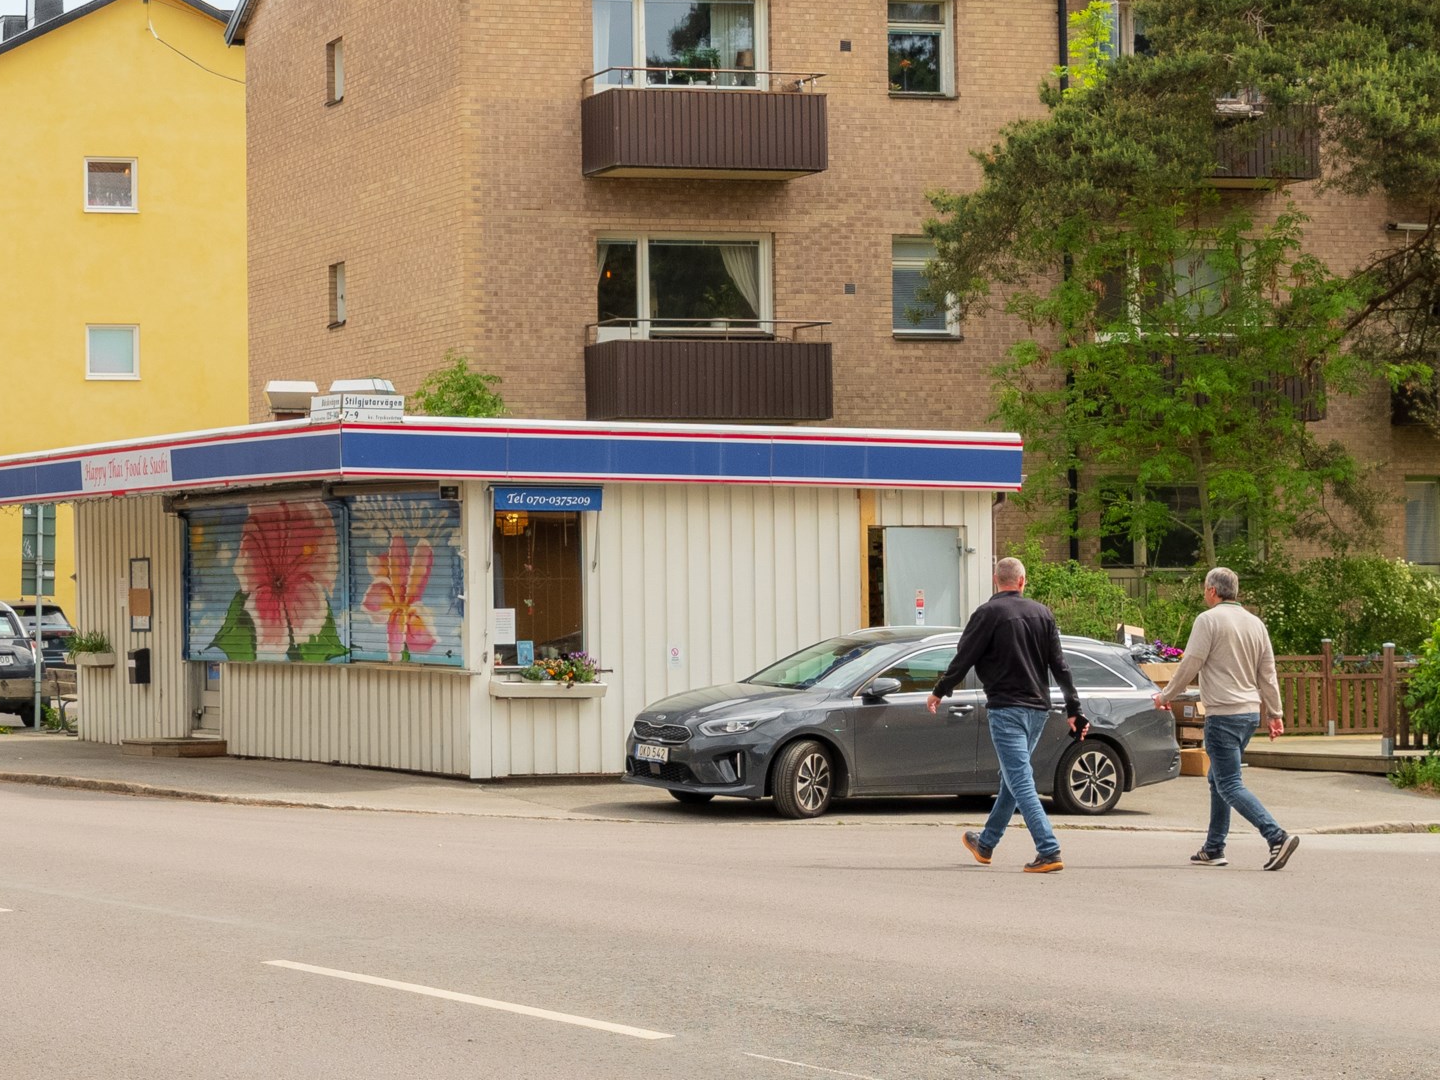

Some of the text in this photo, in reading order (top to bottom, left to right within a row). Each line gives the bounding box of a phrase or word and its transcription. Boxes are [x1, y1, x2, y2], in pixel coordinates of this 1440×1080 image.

[345, 396, 403, 409] Stilgjutarvägen
[344, 410, 359, 419] 7-9
[84, 452, 168, 487] Happy Thai Food & Sushi
[506, 492, 591, 506] Tel 070-0375209
[651, 747, 666, 759] 542
